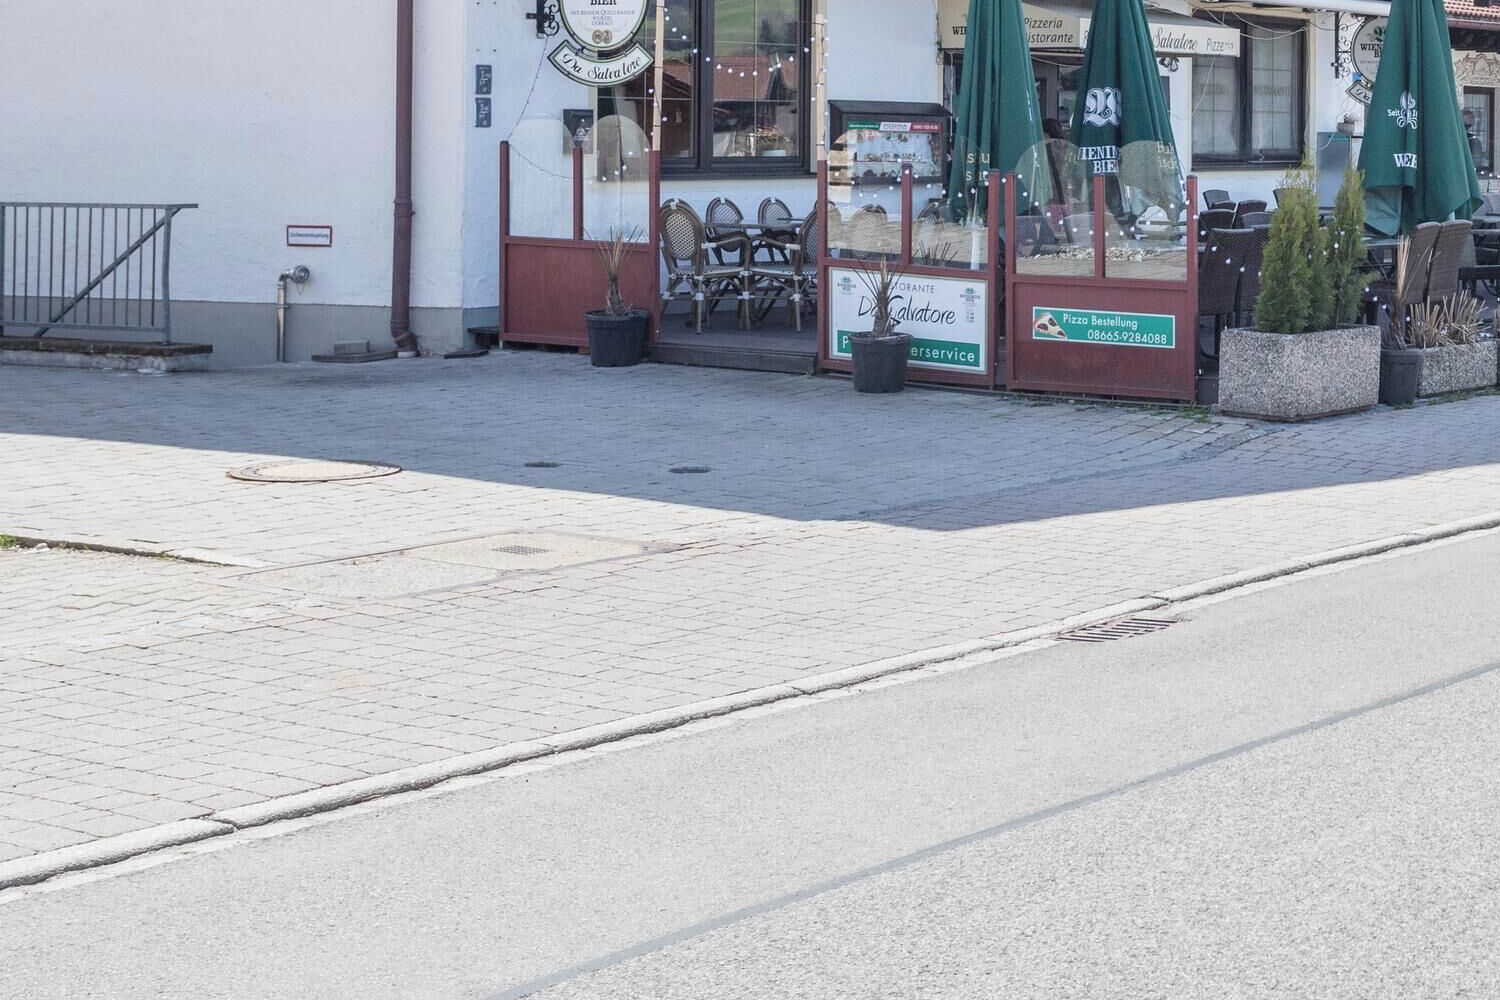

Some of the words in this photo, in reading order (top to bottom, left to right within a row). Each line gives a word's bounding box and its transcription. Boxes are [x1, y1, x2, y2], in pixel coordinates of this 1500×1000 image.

[1024, 17, 1063, 29] Pizzeria
[1026, 32, 1074, 43] istorante
[1153, 27, 1198, 50] Salvatore
[562, 53, 582, 75] Da
[587, 56, 641, 80] Salvatore
[888, 282, 936, 294] STORANTE
[888, 295, 956, 327] Salvatore
[1063, 313, 1089, 325] Pizza
[1091, 315, 1138, 330] Bestellung
[1087, 329, 1168, 345] 08665-9284088
[910, 345, 976, 362] erservice
